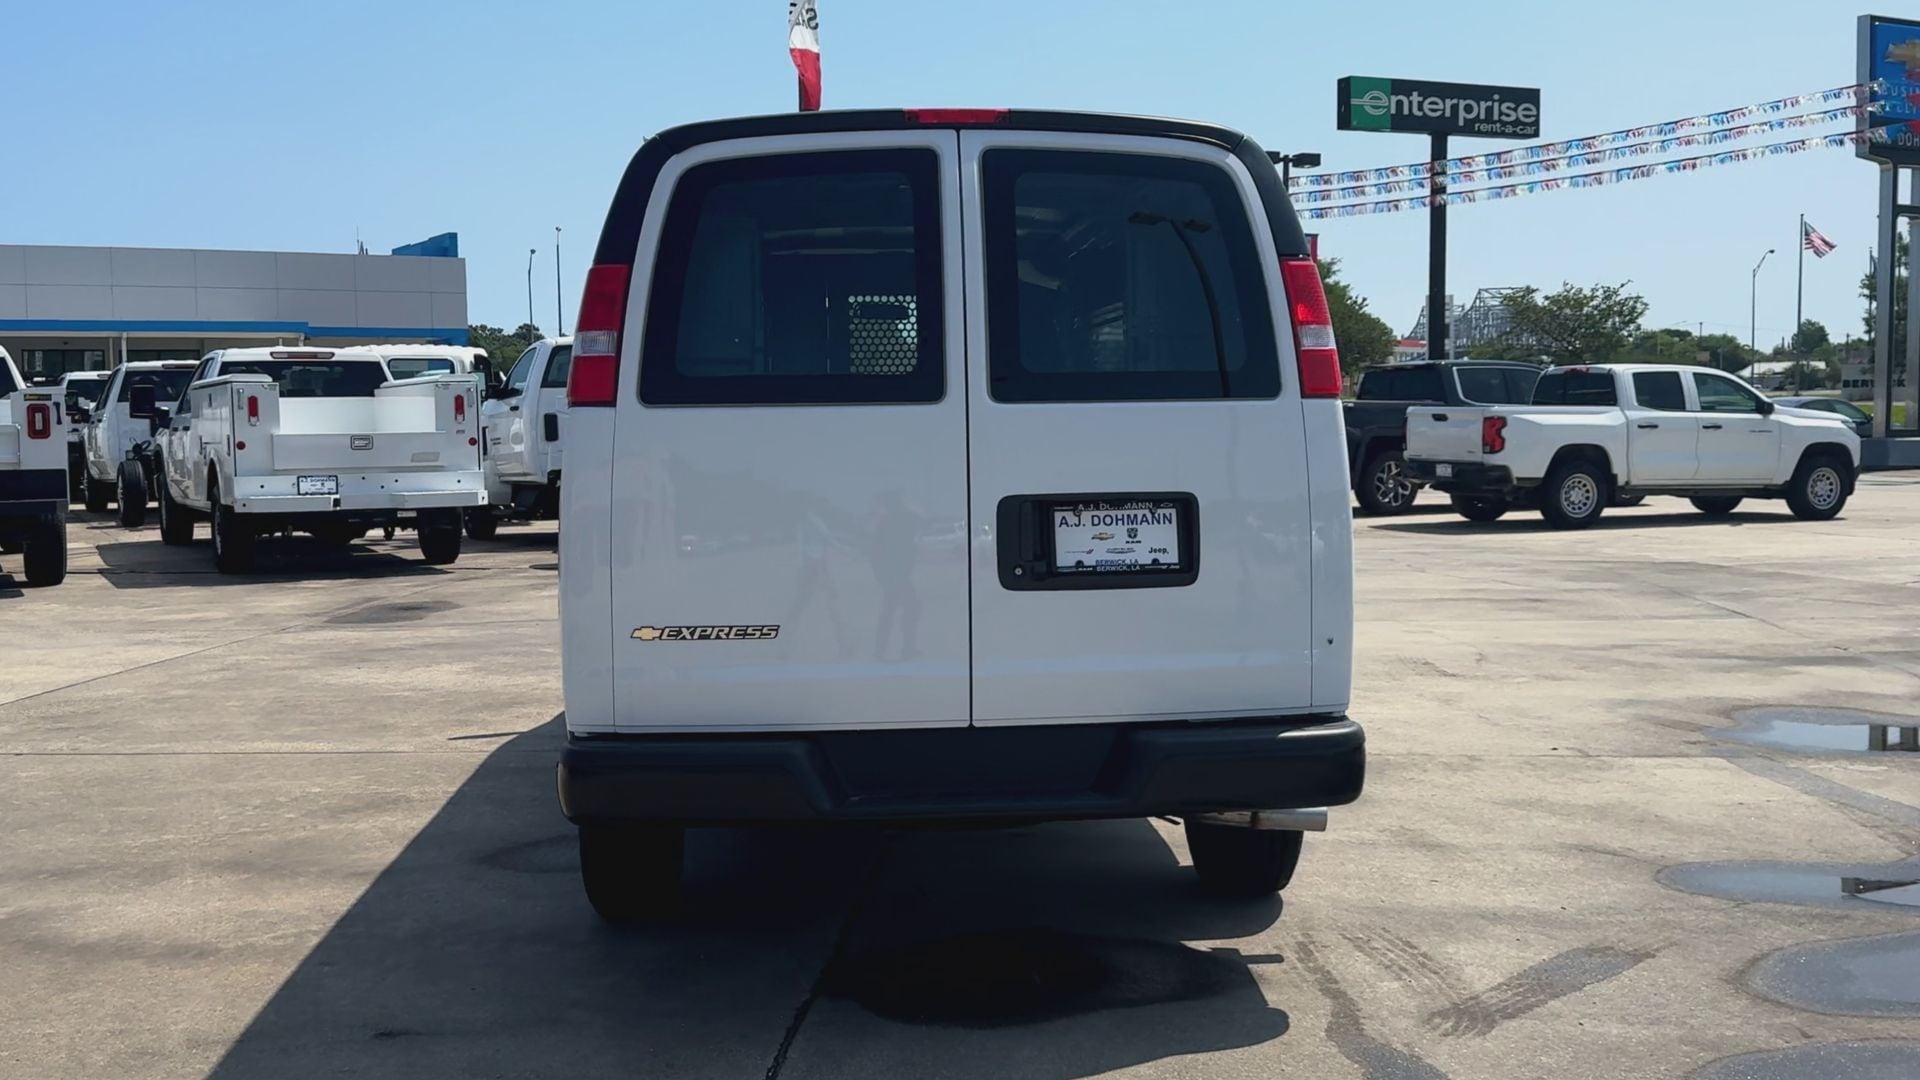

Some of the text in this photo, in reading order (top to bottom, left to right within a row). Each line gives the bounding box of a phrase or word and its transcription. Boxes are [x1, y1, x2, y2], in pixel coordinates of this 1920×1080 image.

[1352, 90, 1538, 126] enterprise
[1474, 121, 1537, 135] rent-a-car
[1058, 512, 1173, 528] A.J. DOHMANN
[660, 625, 779, 640] EXPRESS
